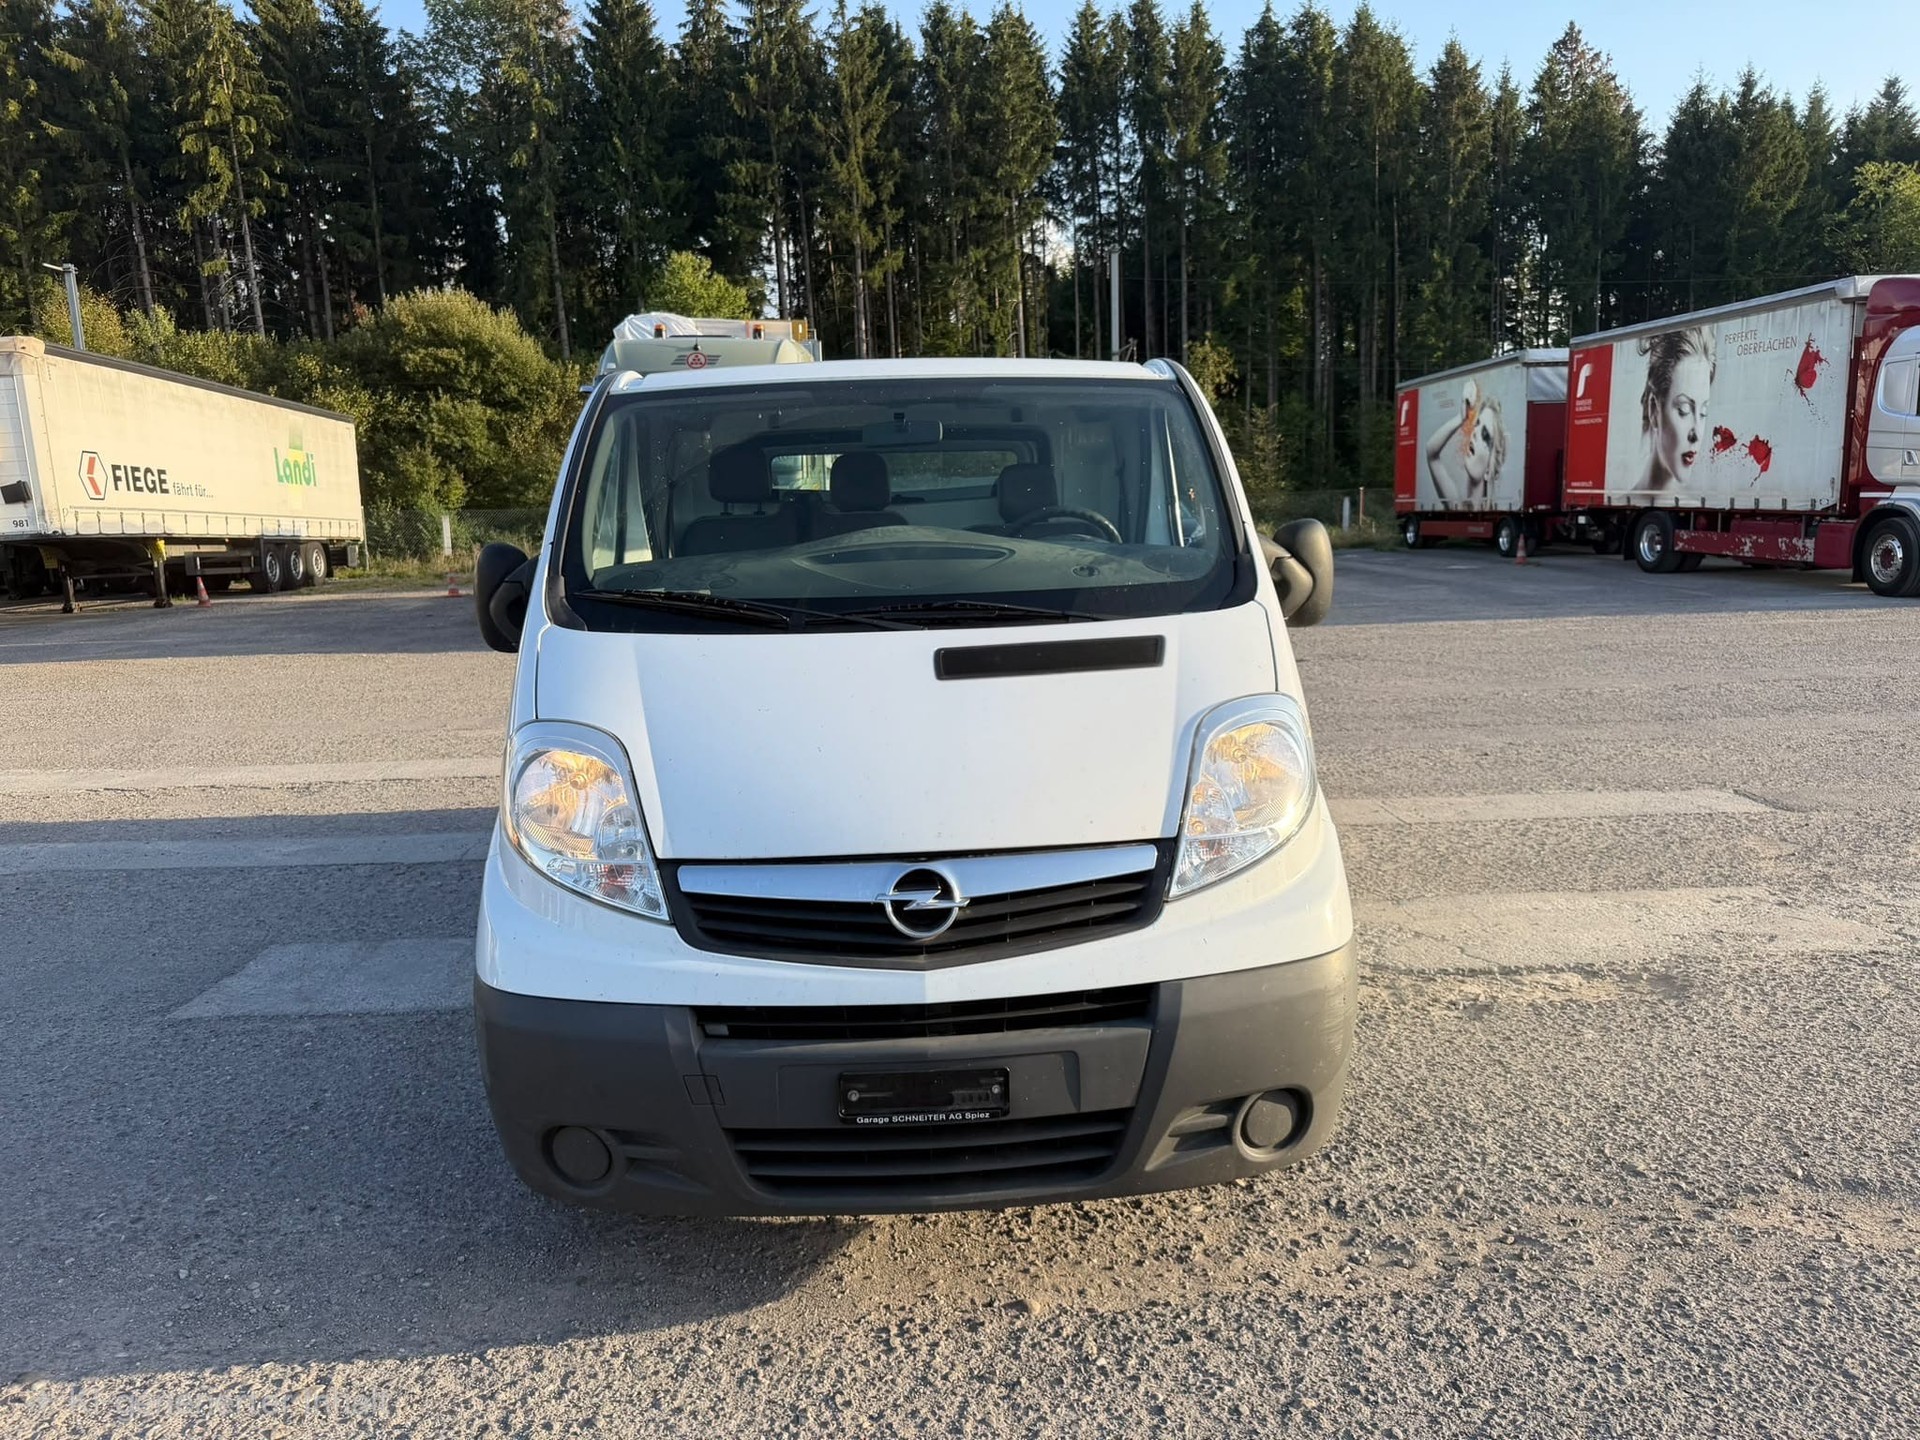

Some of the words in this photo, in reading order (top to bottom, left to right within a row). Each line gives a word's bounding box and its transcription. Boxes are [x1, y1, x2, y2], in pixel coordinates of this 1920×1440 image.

[1725, 329, 1758, 344] PERFEKTE
[1737, 336, 1797, 356] OBERFLÄCHEN
[274, 447, 317, 487] Landi
[111, 464, 170, 494] FIEGE
[173, 482, 194, 497] fährt
[12, 519, 29, 528] 981
[856, 1116, 890, 1125] Garage
[892, 1113, 946, 1123] SCHNEITER
[948, 1112, 963, 1120] AG
[965, 1111, 990, 1120] Spiez
